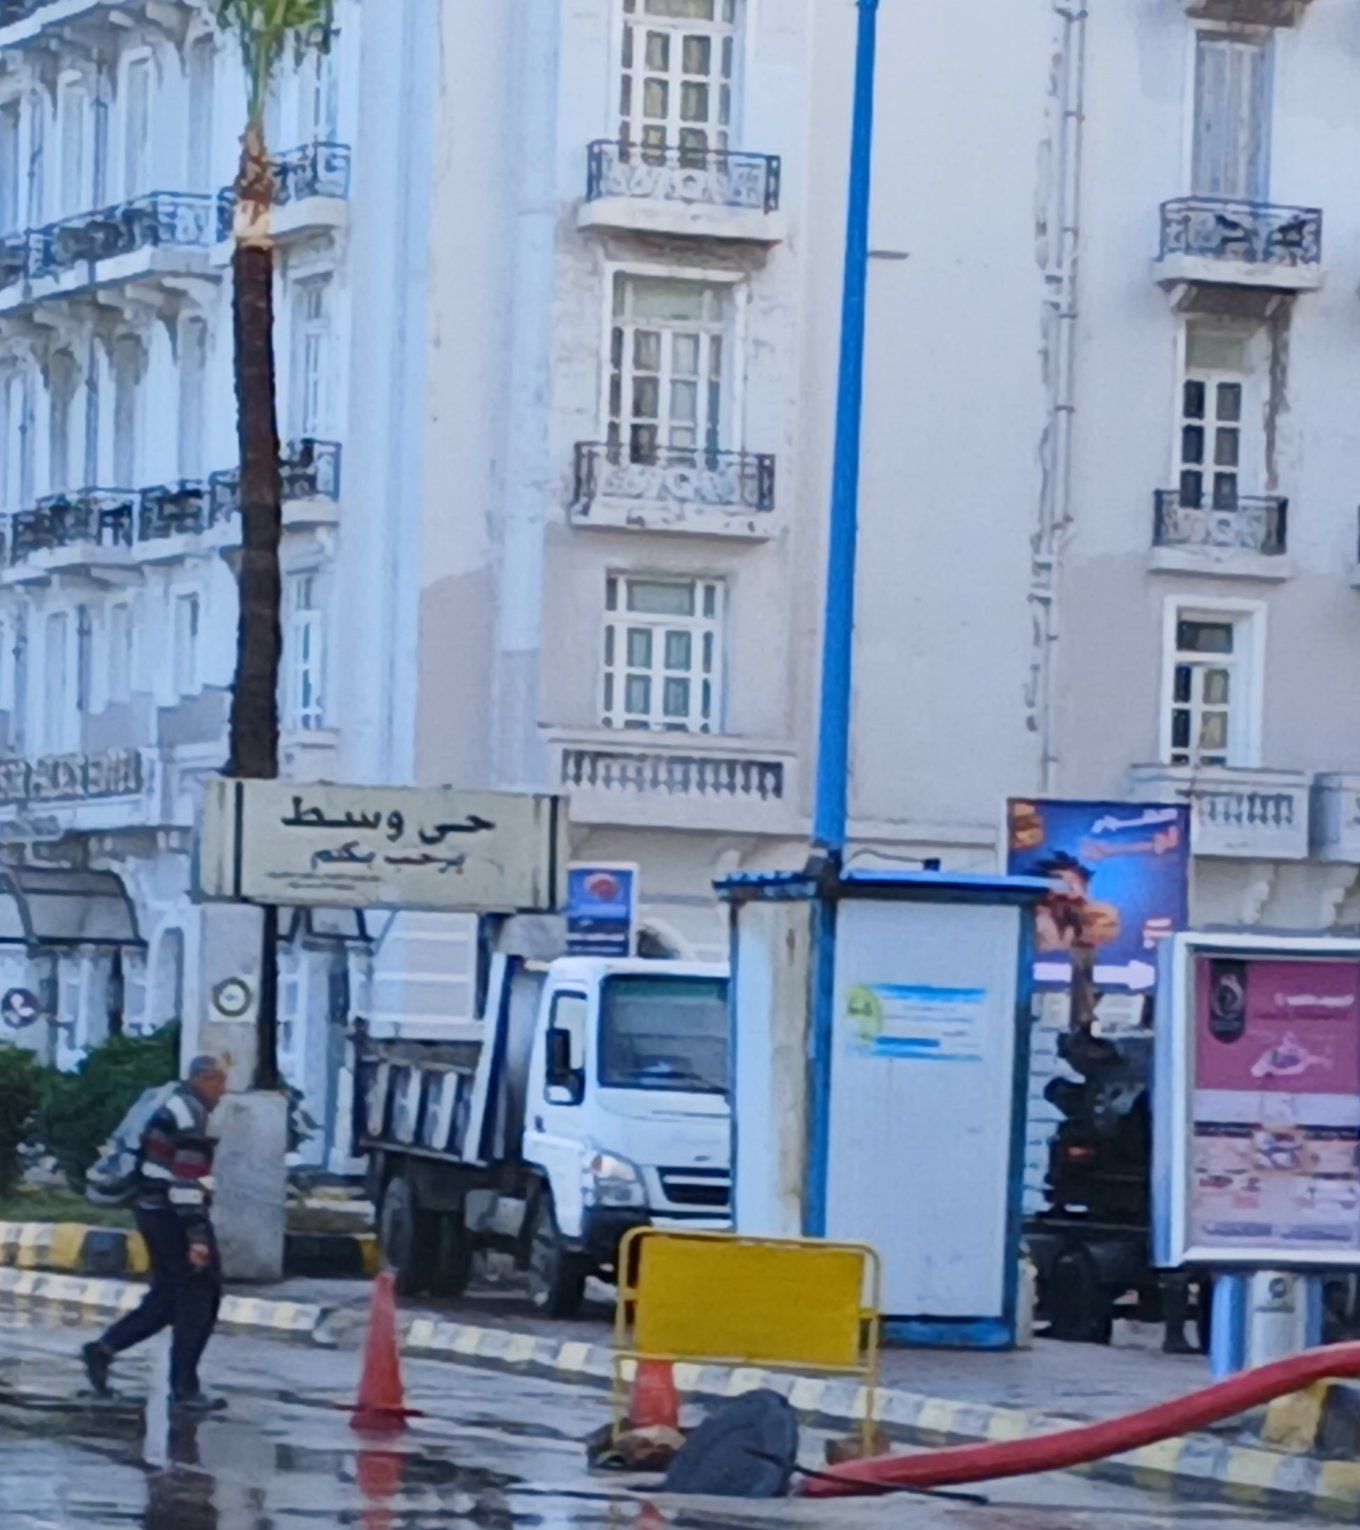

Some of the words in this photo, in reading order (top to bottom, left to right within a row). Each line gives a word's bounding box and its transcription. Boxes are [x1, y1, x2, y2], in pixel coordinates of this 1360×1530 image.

[280, 795, 406, 843] وسط
[310, 840, 377, 872] بكم
[383, 852, 467, 875] يرحب
